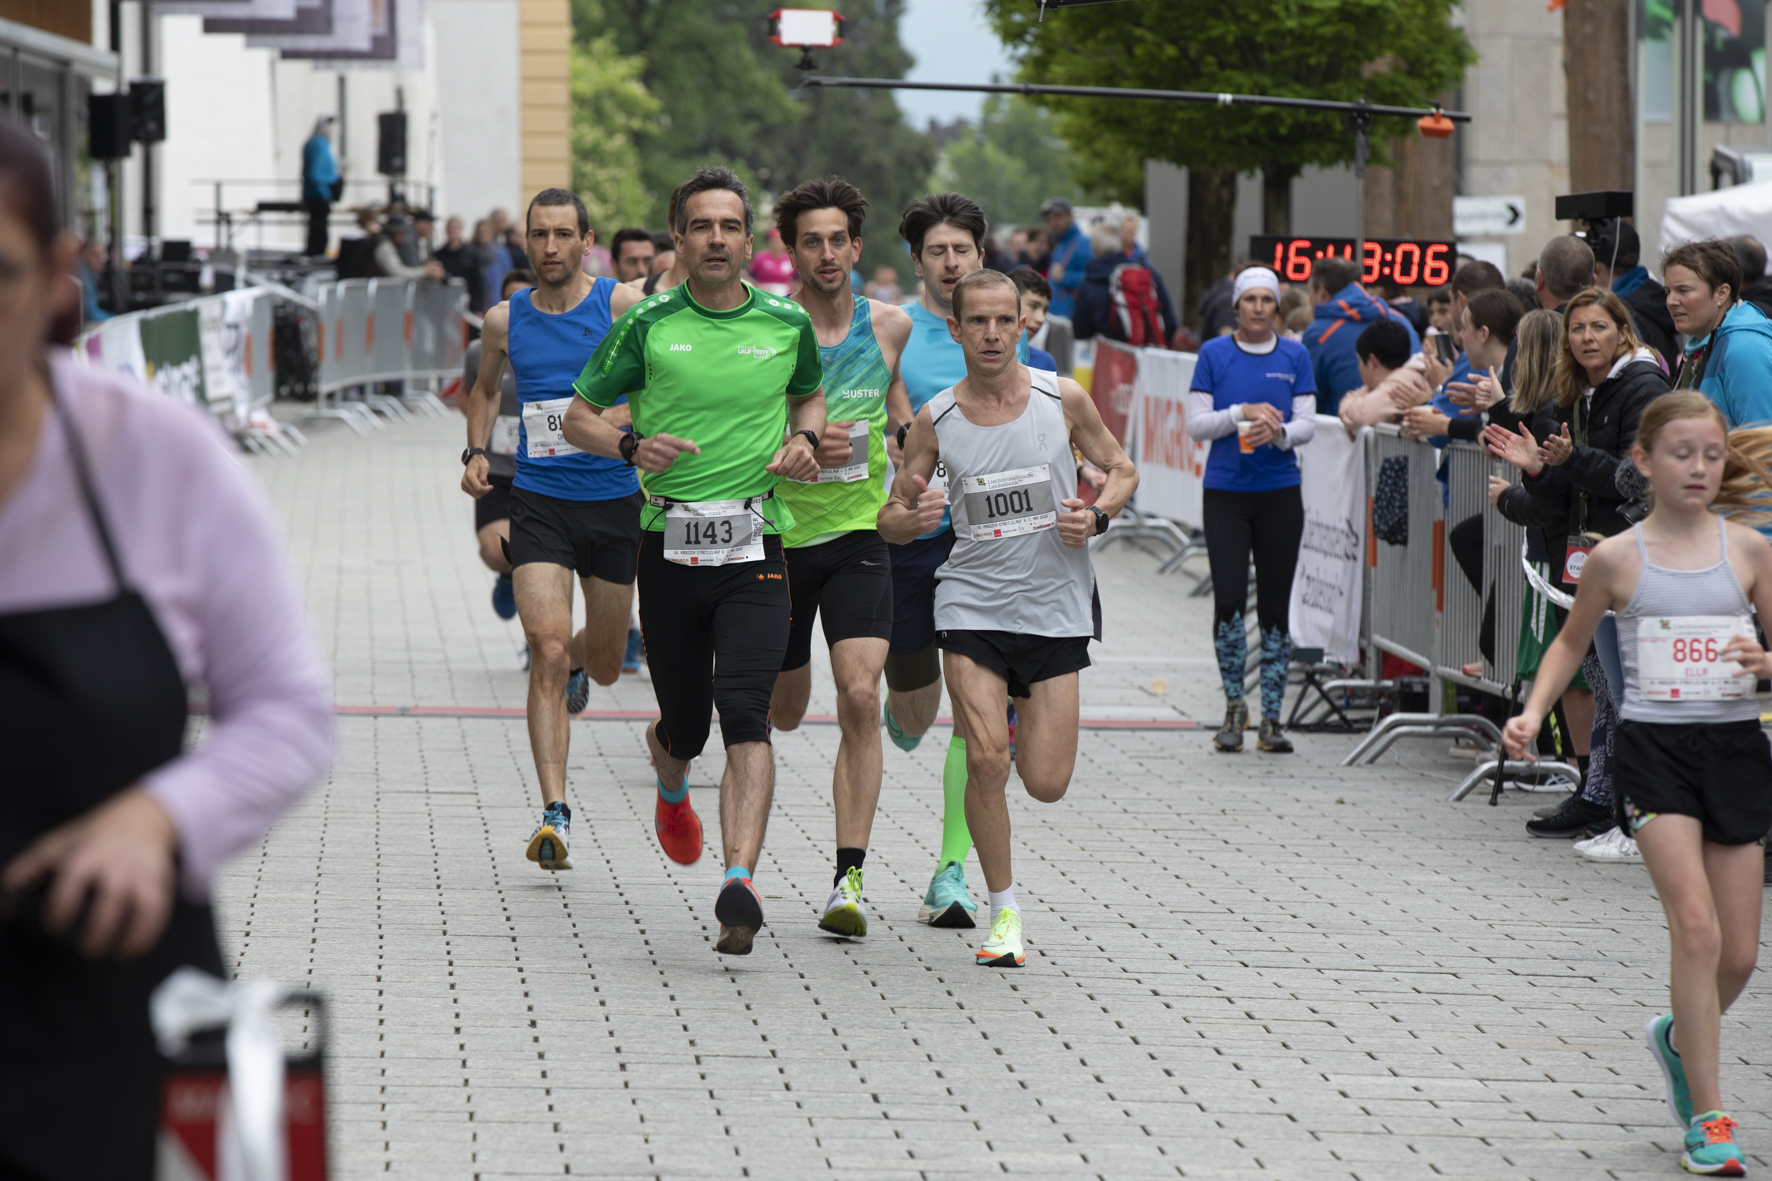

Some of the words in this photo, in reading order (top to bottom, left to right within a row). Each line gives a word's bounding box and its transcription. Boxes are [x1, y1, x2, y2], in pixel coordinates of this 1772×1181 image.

[850, 389, 880, 398] USTER
[1142, 393, 1204, 478] MIGRO
[988, 472, 1034, 484] Liechtensteinische
[988, 480, 1018, 489] Landesbank
[986, 488, 1033, 518] 1001
[685, 520, 732, 544] 1143
[1673, 638, 1718, 662] 866
[1685, 668, 1709, 677] ELLA
